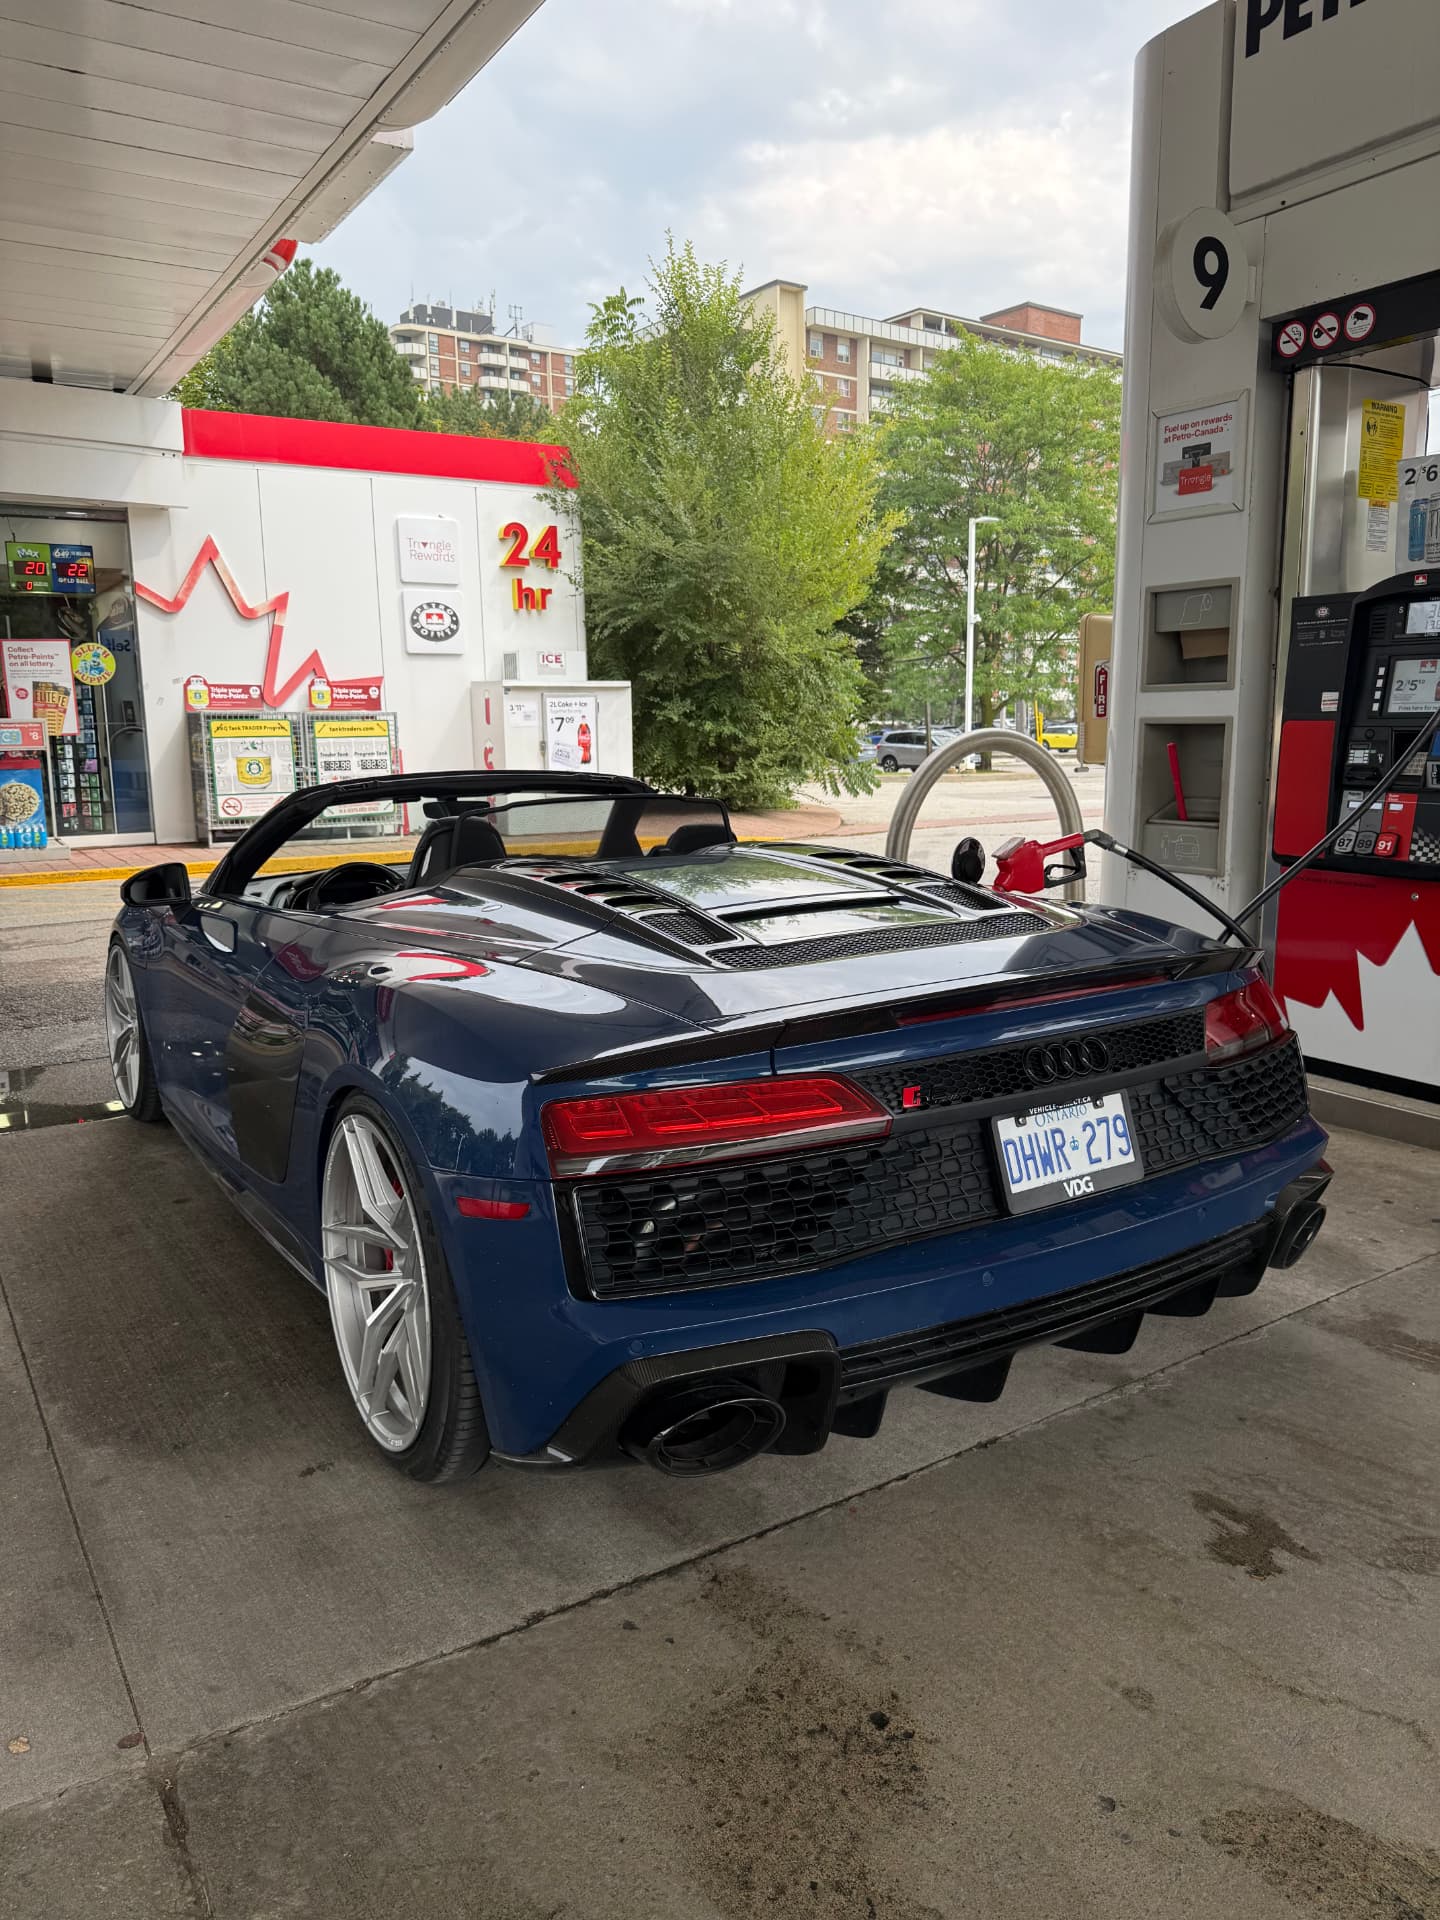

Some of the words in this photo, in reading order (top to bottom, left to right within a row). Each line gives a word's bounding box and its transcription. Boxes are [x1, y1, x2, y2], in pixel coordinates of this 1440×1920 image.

[1193, 236, 1229, 311] 9
[1371, 401, 1398, 414] WARNING
[1164, 424, 1179, 434] Fuel
[1180, 422, 1189, 432] up
[1191, 420, 1200, 429] on
[1201, 413, 1233, 426] rewards
[1164, 436, 1171, 444] at
[1172, 425, 1224, 442] Petro-Canada
[498, 522, 562, 570] 24
[410, 549, 456, 562] Rewards
[25, 561, 45, 575] 20
[68, 563, 88, 577] 22
[512, 578, 552, 611] hr
[415, 602, 453, 616] PETRO
[413, 621, 457, 639] POINTS
[542, 654, 563, 664] ICE
[209, 686, 227, 694] Triple
[228, 688, 243, 696] your
[350, 688, 362, 696] your
[1098, 674, 1106, 715] FIRE
[1337, 837, 1352, 848] 87
[1377, 840, 1392, 851] 91
[1034, 1104, 1088, 1128] ONTARIO
[1003, 1127, 1072, 1185] DHWR
[1081, 1113, 1132, 1165] 279
[1063, 1175, 1095, 1198] VDG
